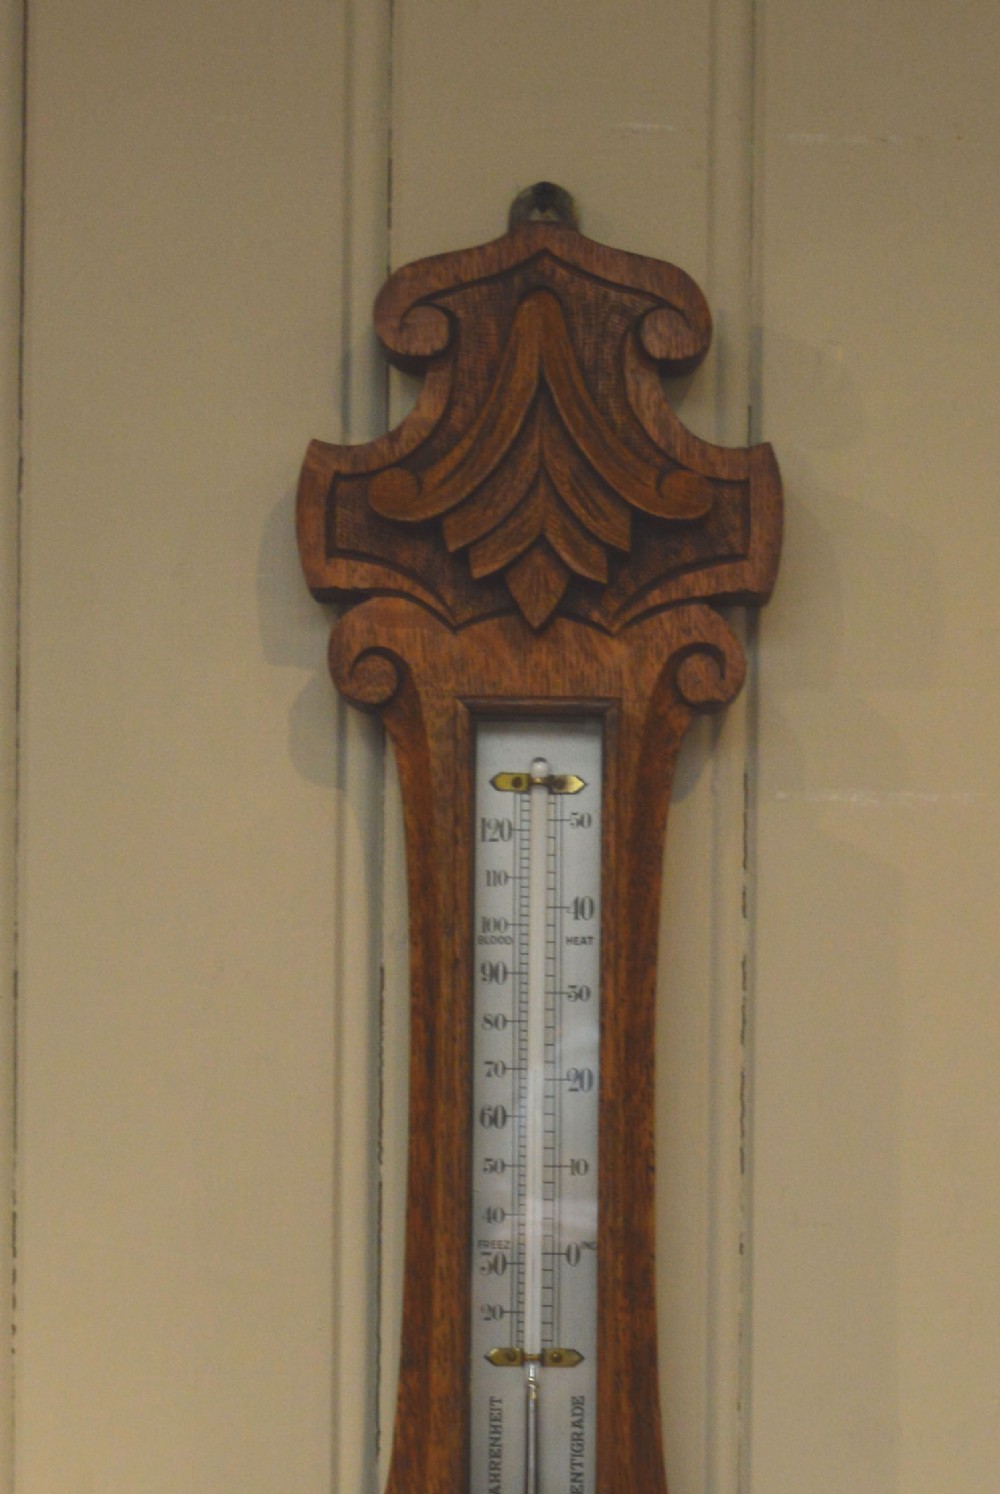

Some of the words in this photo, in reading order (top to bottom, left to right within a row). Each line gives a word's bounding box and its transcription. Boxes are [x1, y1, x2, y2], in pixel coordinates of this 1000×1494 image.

[480, 817, 512, 842] 120
[570, 812, 592, 829] 50
[486, 870, 508, 887] 110
[567, 895, 595, 921] 40
[481, 916, 508, 934] 100
[478, 936, 513, 945] BLOOD
[565, 936, 595, 945] HEAT
[480, 961, 507, 985] 90
[481, 1013, 507, 1031] 80
[484, 1060, 506, 1078] 70
[566, 1067, 593, 1093] 20
[480, 1104, 507, 1129] 60
[483, 1158, 506, 1175] 50
[569, 1158, 589, 1176] 10
[484, 1206, 505, 1223] 40
[565, 1242, 581, 1267] 0
[481, 1304, 504, 1321] 20
